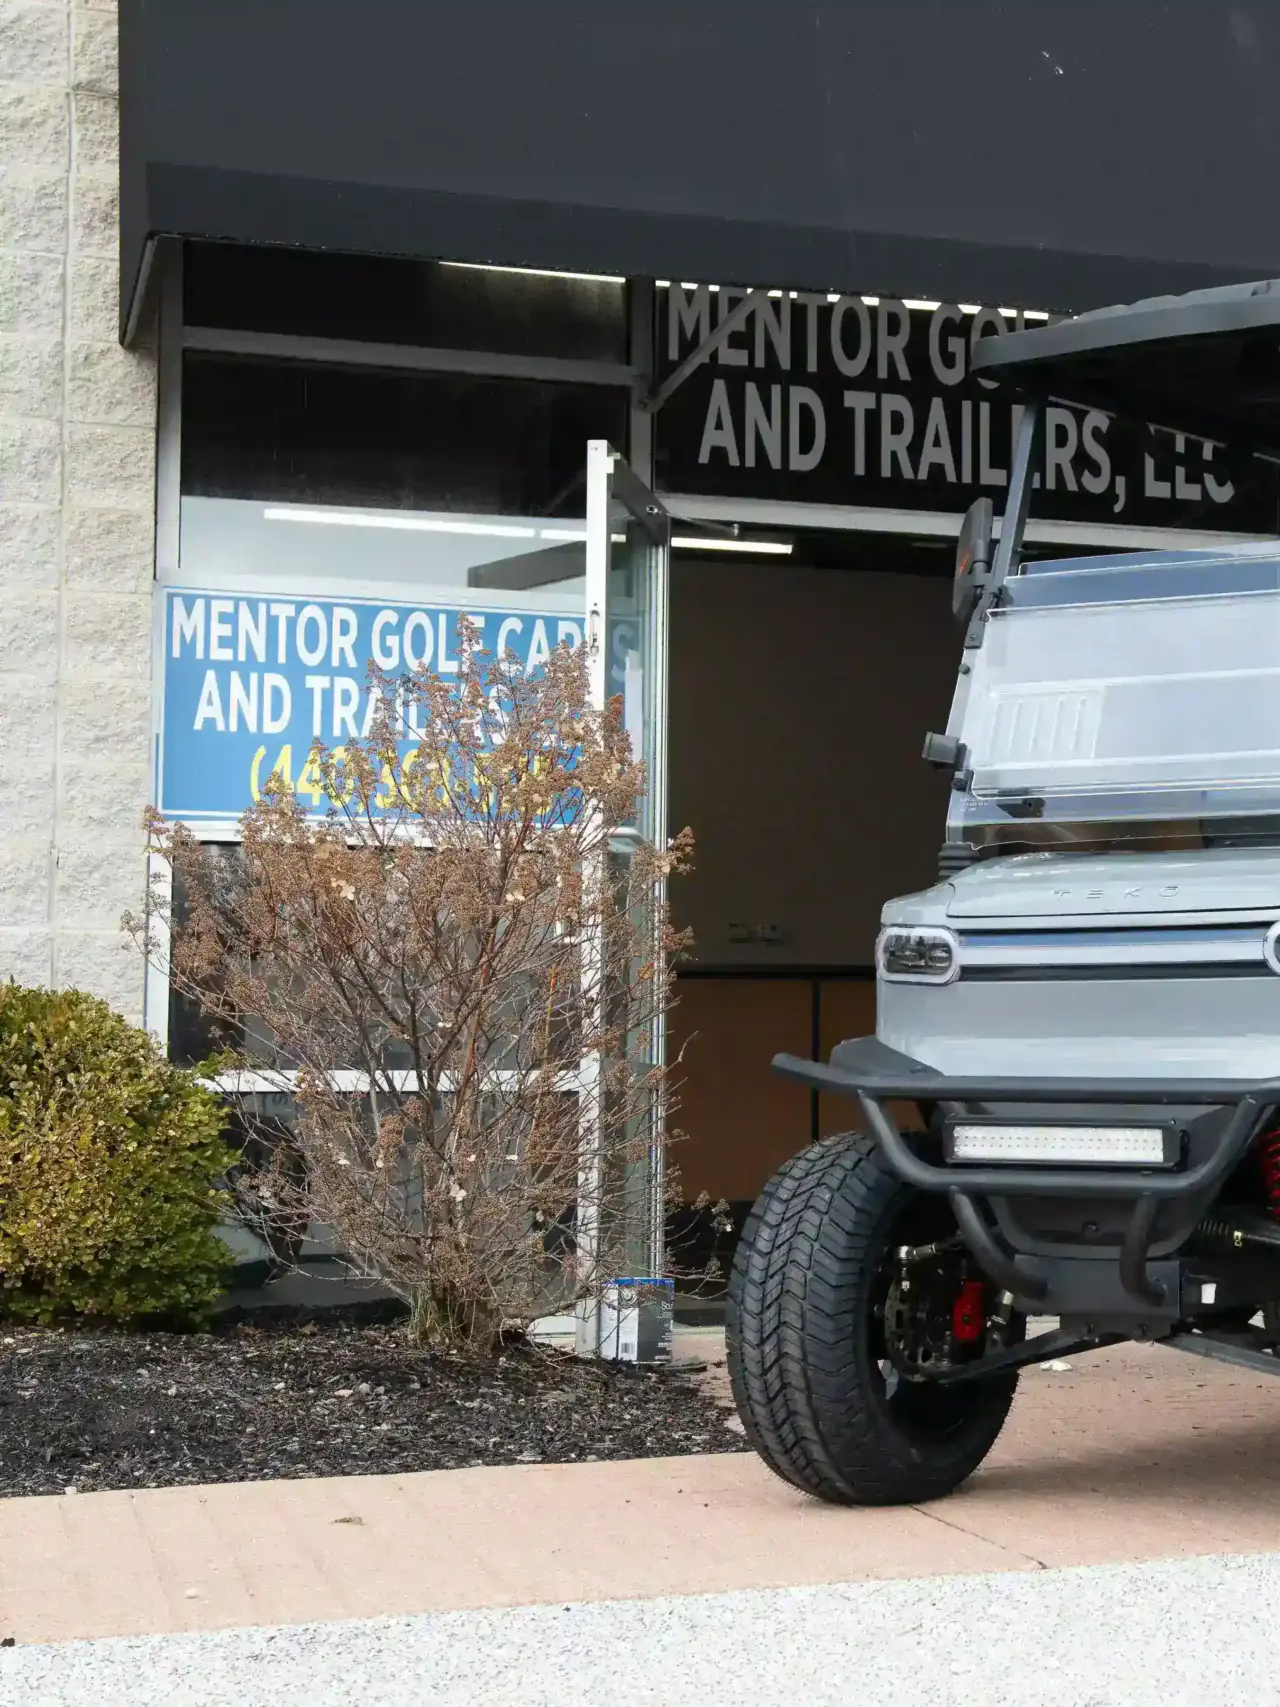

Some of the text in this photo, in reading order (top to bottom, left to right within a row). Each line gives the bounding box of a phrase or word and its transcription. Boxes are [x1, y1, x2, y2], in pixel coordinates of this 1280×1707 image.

[668, 281, 1062, 390] MENTOR GO
[698, 378, 826, 471] AND
[172, 597, 636, 683] MENTOR GOLF CAS
[193, 669, 513, 747] AND TRAILS
